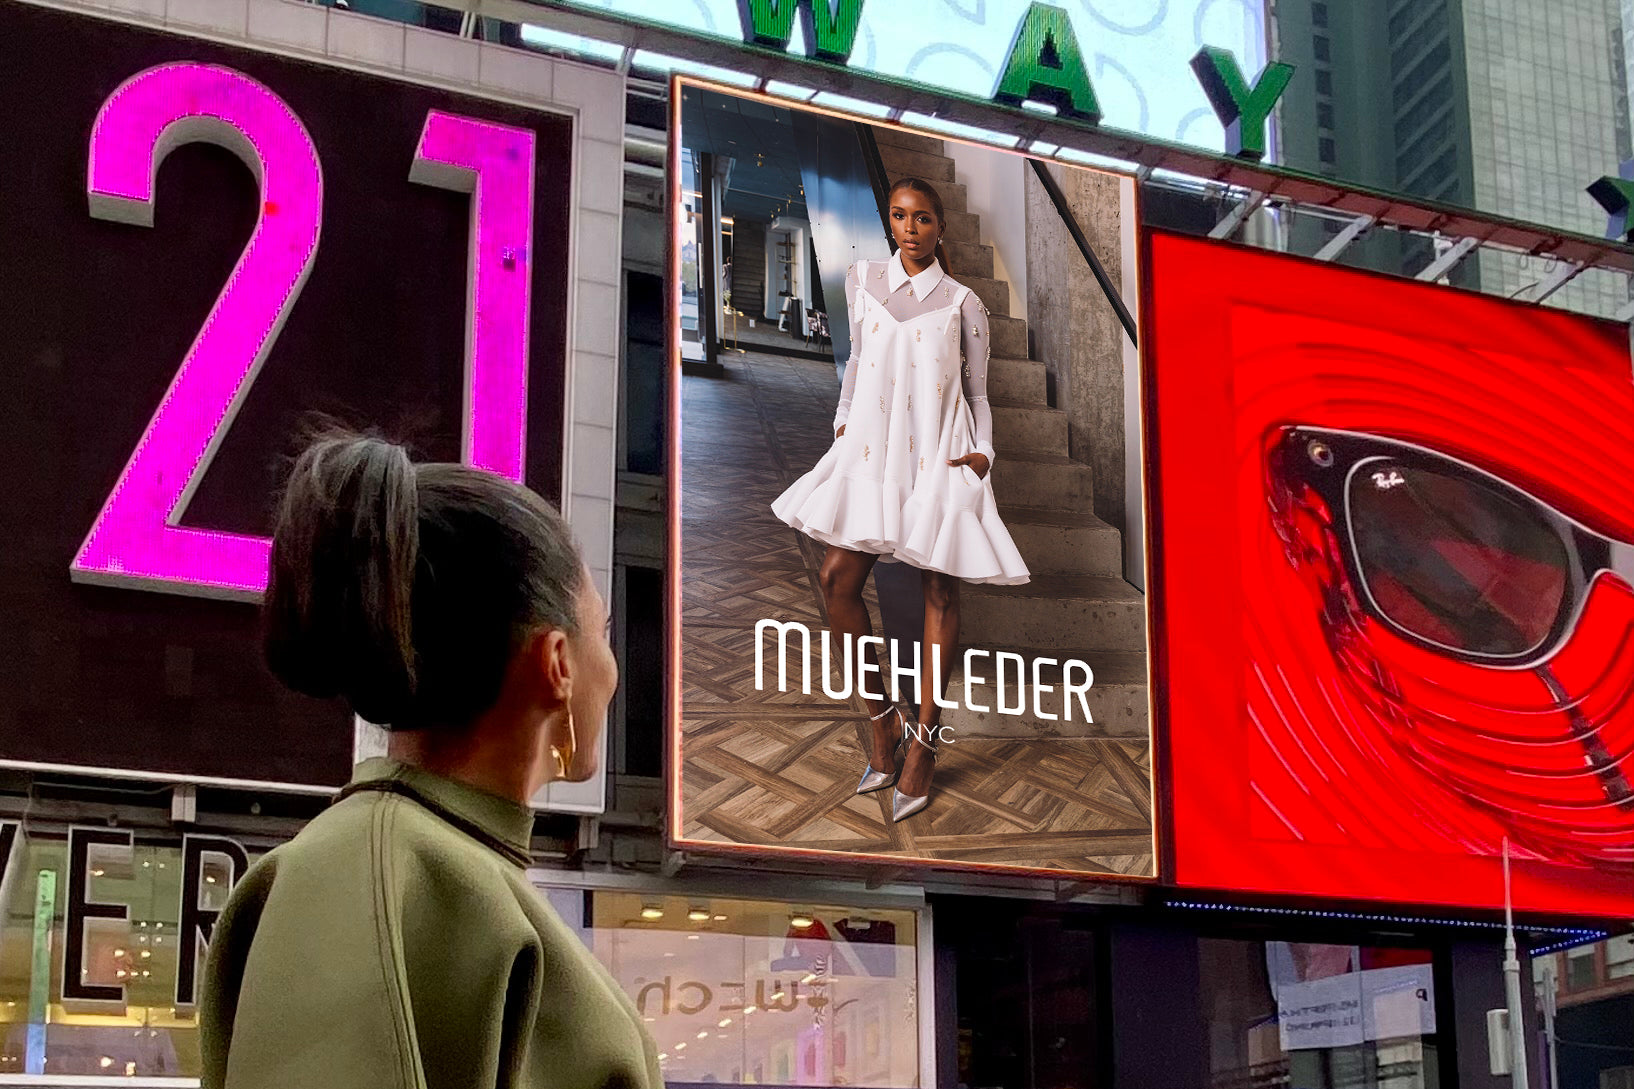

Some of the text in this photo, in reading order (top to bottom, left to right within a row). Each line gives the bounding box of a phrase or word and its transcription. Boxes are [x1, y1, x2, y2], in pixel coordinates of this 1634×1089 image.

[71, 61, 537, 604] 21
[754, 618, 1094, 724] MUEHLEDER
[904, 722, 956, 744] NYC
[0, 819, 250, 1006] ER
